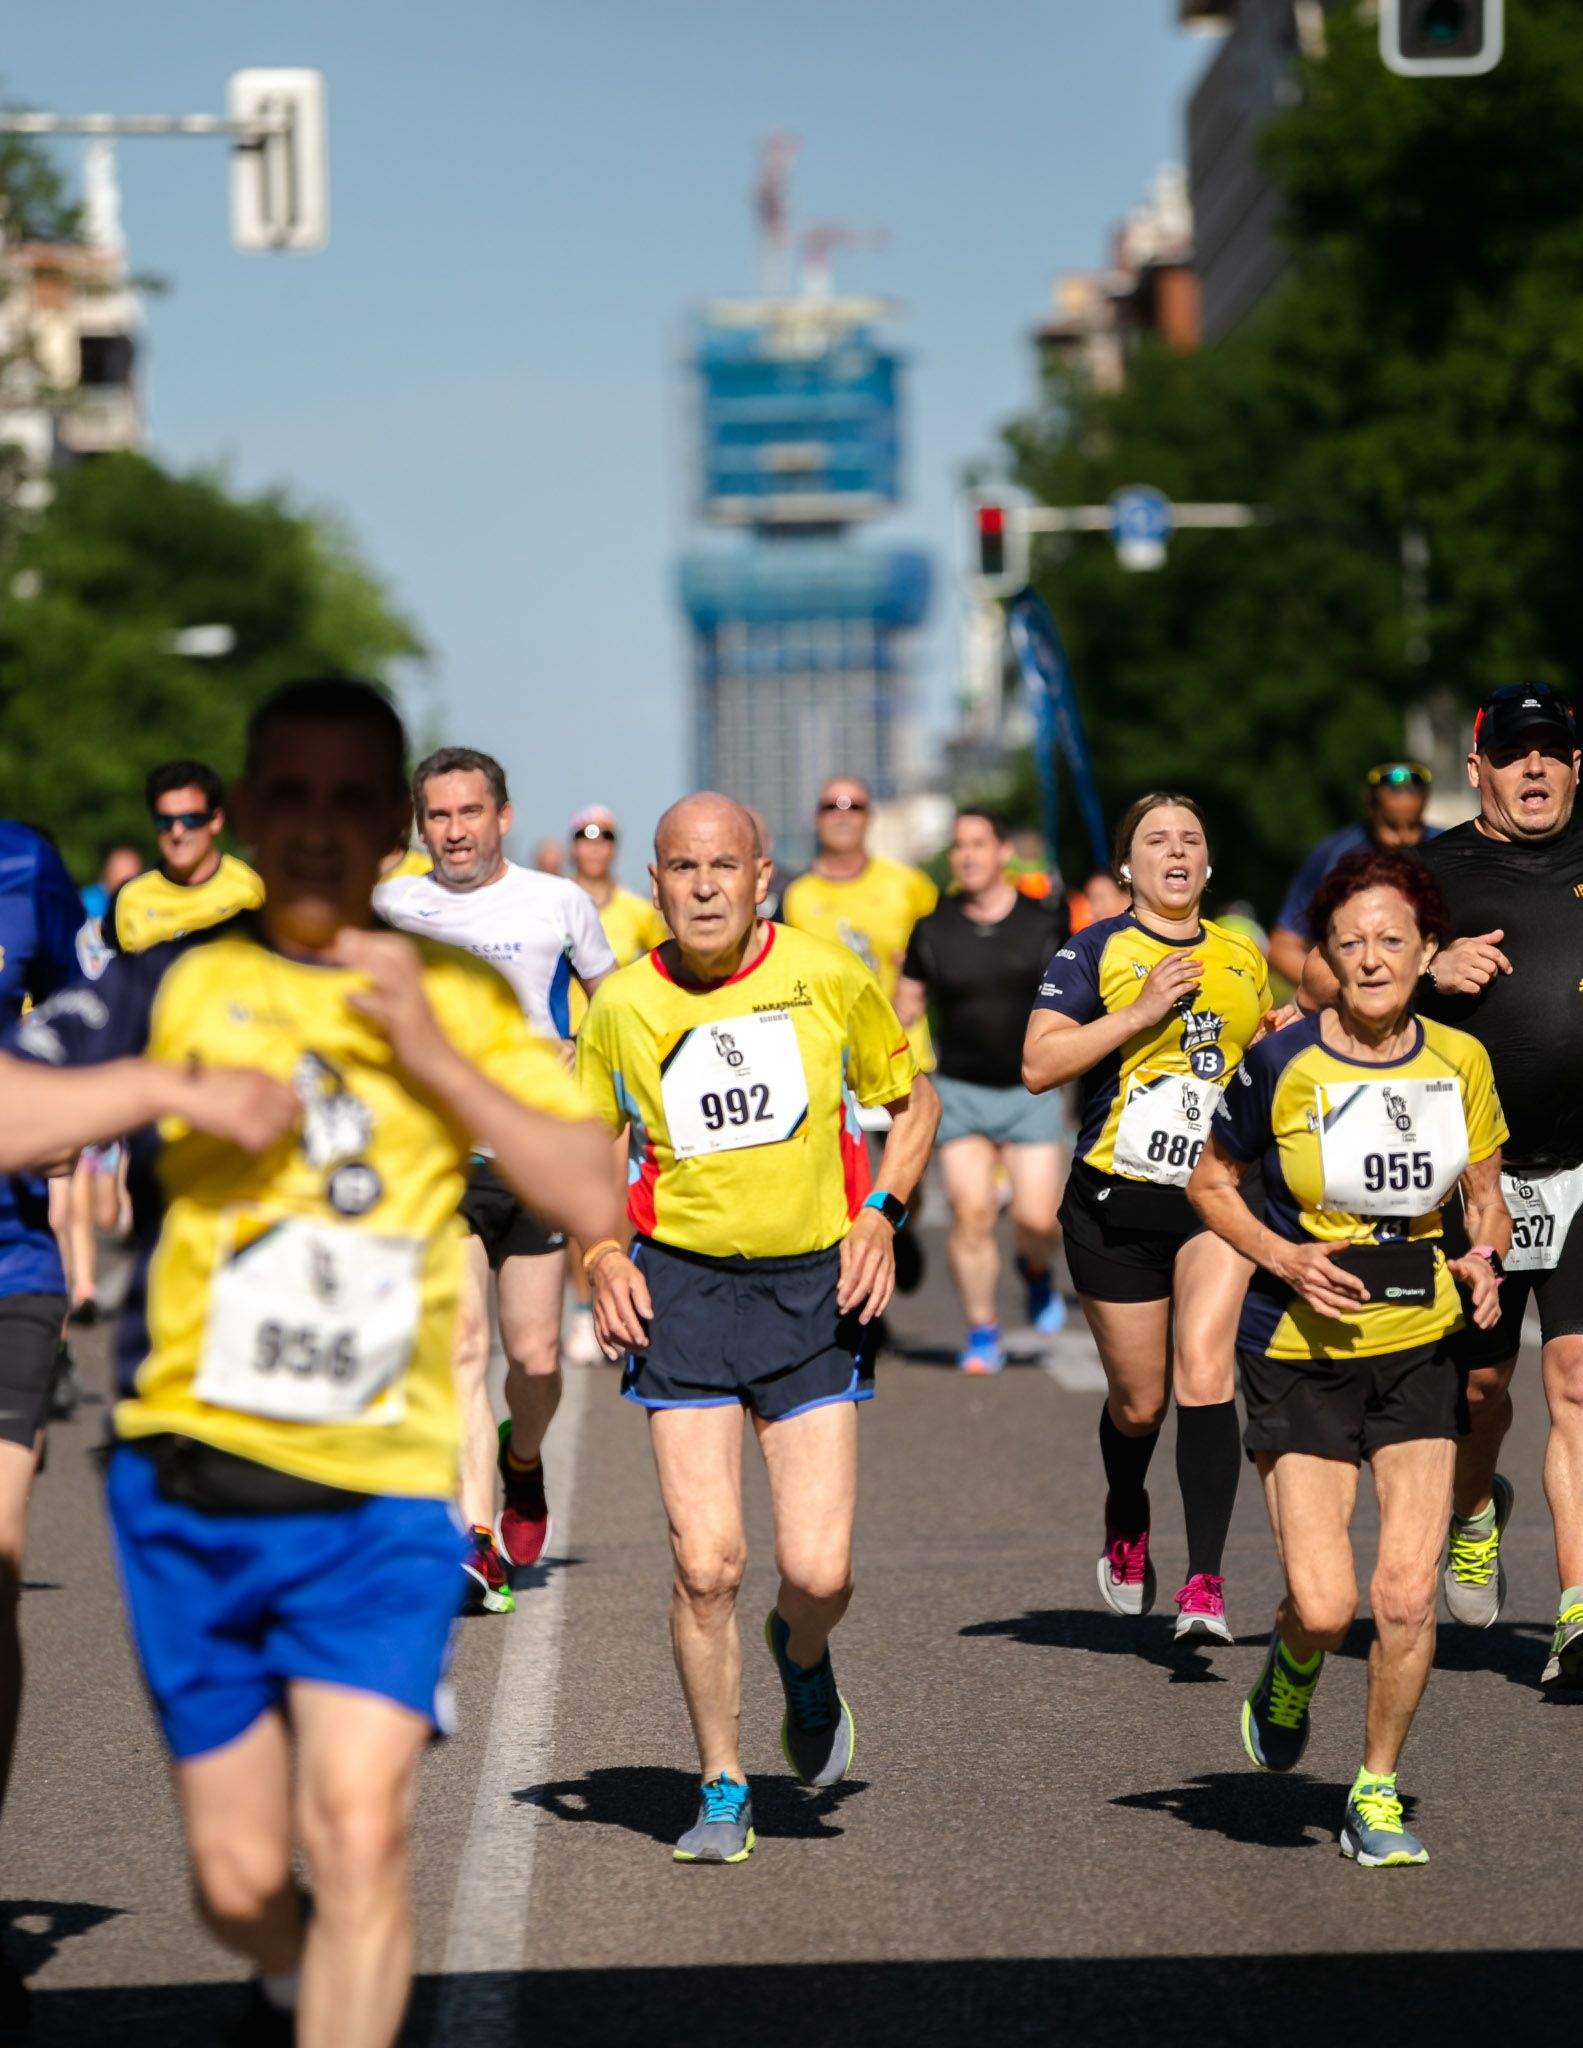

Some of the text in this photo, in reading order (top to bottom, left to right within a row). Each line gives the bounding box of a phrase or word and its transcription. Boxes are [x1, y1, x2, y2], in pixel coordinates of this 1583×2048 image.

[1195, 1051, 1218, 1073] 13
[701, 1082, 774, 1131] 992
[1364, 1151, 1434, 1192] 955
[1520, 1187, 1532, 1198] 13
[1512, 1214, 1555, 1249] 527
